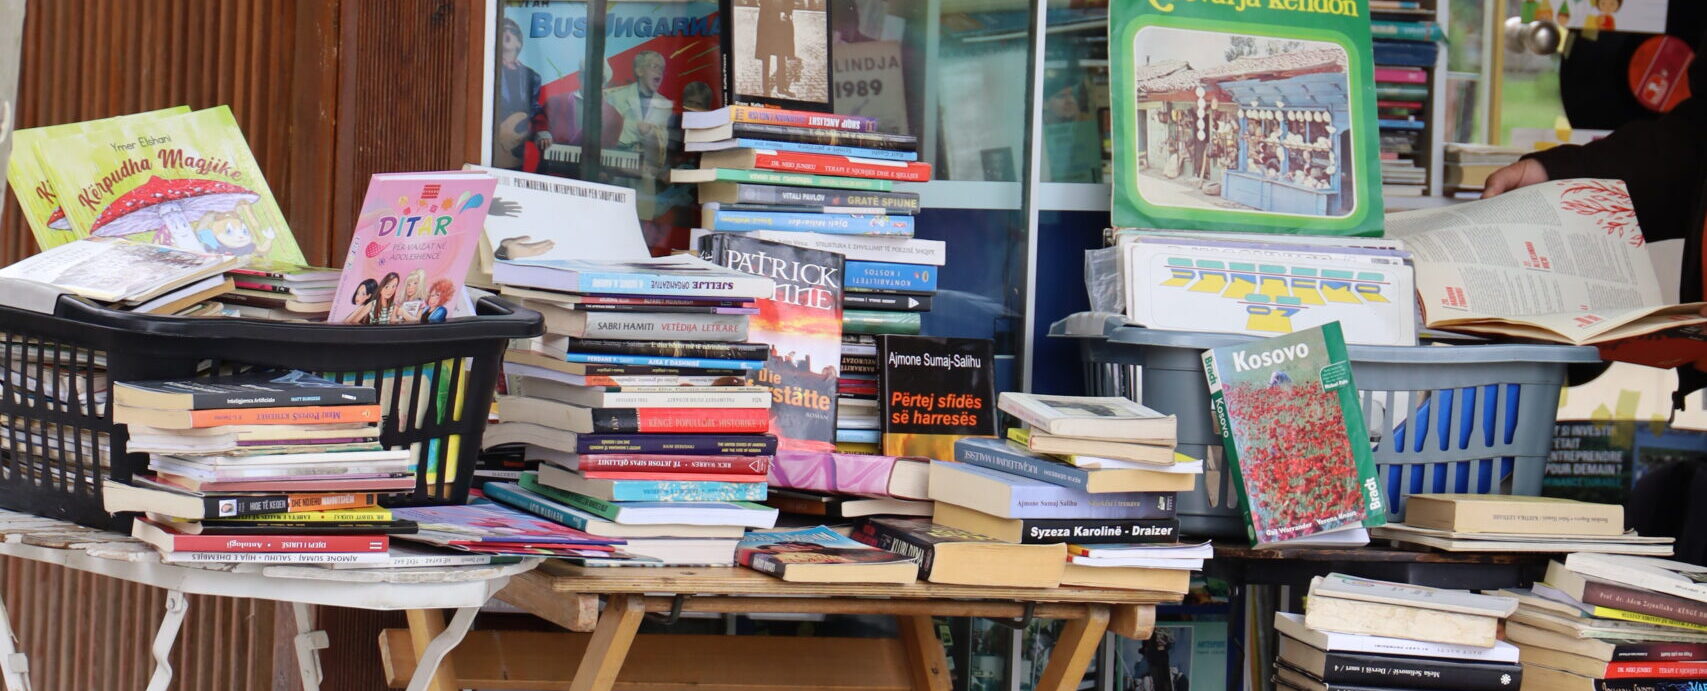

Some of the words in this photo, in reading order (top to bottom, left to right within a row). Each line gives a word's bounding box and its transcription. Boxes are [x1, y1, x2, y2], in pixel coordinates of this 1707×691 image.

[834, 79, 883, 97] 1989
[158, 148, 243, 181] Magjike
[802, 193, 825, 202] PAVLOV
[848, 195, 879, 206] GRATË
[882, 197, 918, 208] SPIUNE
[378, 215, 454, 238] DITAR
[726, 250, 838, 289] PATRICK
[692, 282, 734, 290] SJELLJE
[771, 281, 832, 310] NNE
[597, 322, 621, 330] SABRI
[622, 322, 654, 331] HAMITI
[701, 324, 739, 332] LETRARE
[888, 352, 922, 368] Ajmone
[924, 352, 982, 369] Sumaj-Salihu
[1232, 342, 1310, 372] Kosovo
[759, 368, 782, 385] Die
[891, 391, 934, 410] Përtej
[937, 392, 982, 410] sfidës
[1204, 356, 1216, 386] Bradt
[1215, 397, 1229, 438] Kosovo
[892, 410, 910, 426] së
[914, 410, 977, 426] harresës
[1549, 450, 1622, 462] NTREPRENDRE
[1364, 477, 1381, 511] Bradt
[1030, 526, 1070, 539] Syzeza
[1074, 525, 1122, 537] Karolinë
[1132, 524, 1173, 537] Draizer
[226, 540, 262, 549] Antologji
[1366, 667, 1387, 675] Derviš
[1393, 668, 1424, 677] Selimović
[1424, 670, 1441, 678] Meša
